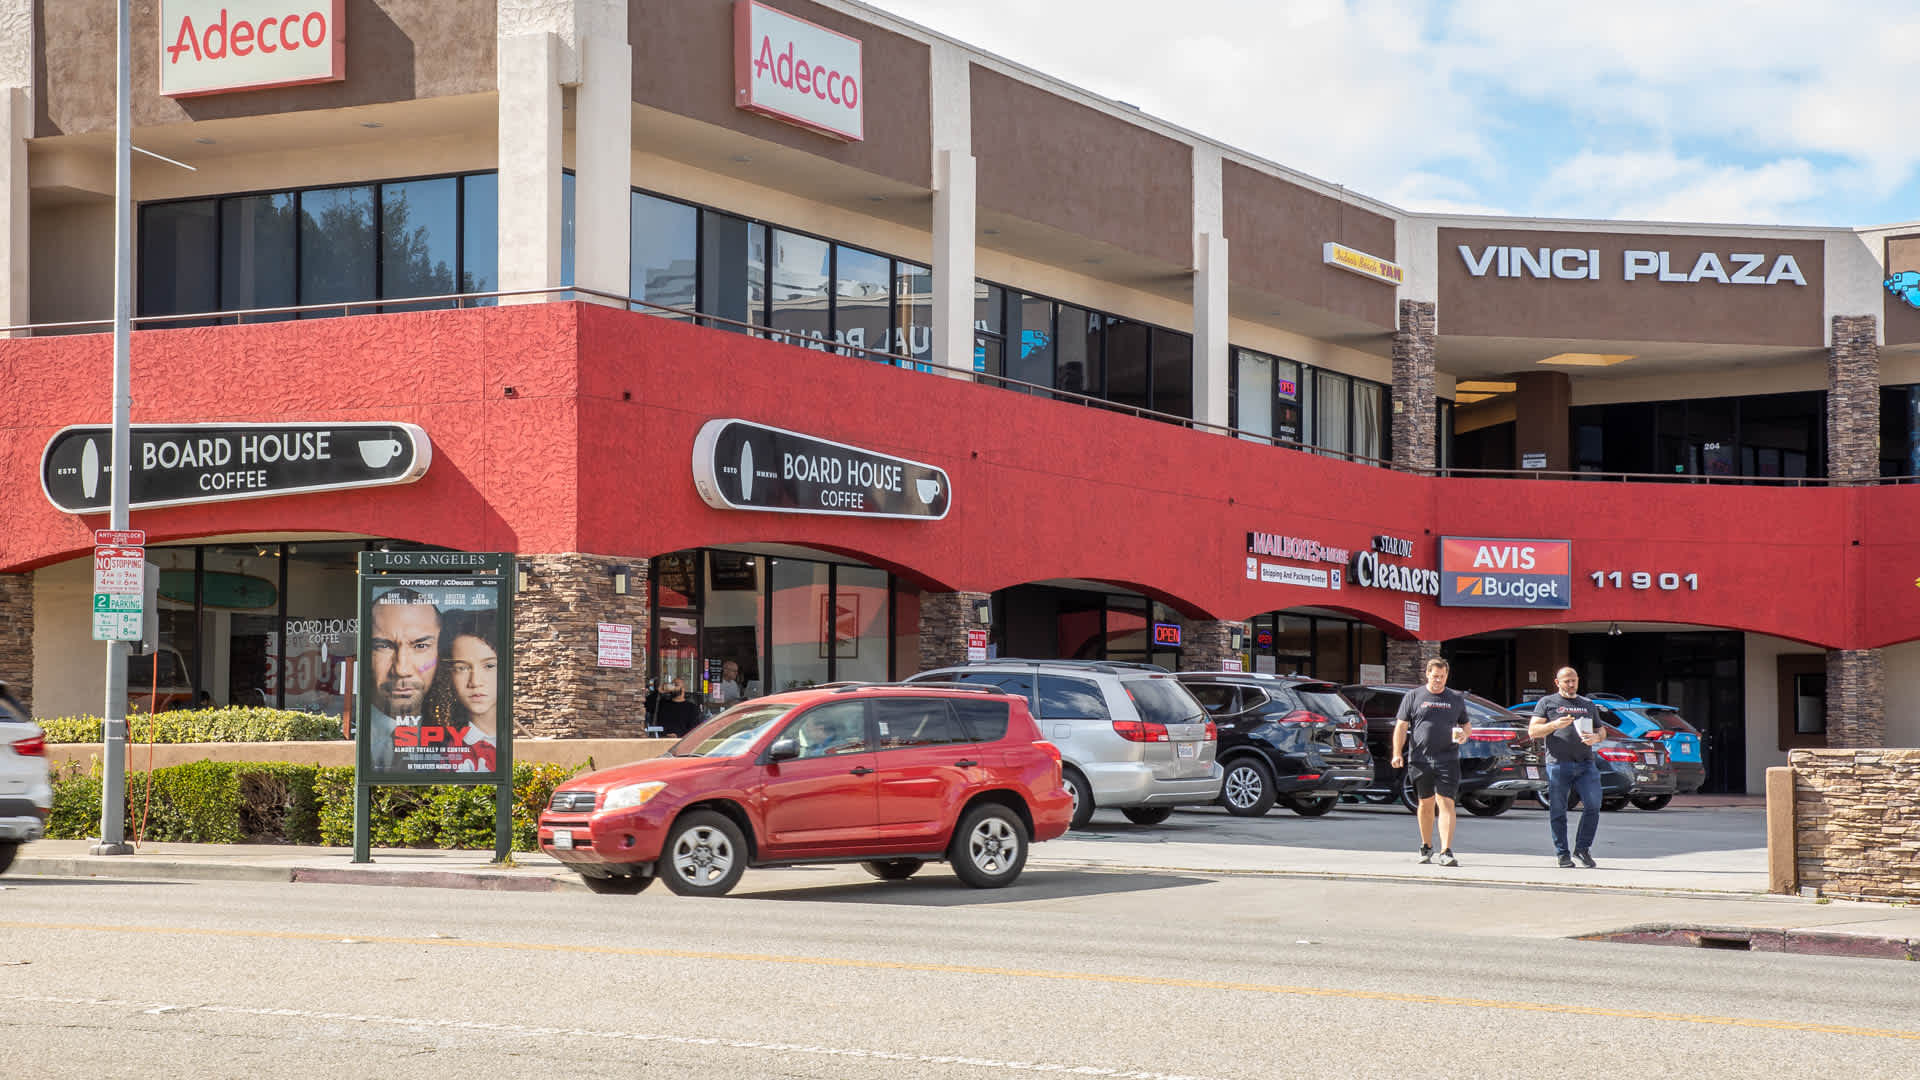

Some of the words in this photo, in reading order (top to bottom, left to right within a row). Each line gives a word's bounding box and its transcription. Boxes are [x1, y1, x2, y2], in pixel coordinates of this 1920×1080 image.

[166, 8, 327, 64] Adecco
[753, 34, 858, 110] Adecco
[1458, 245, 1601, 281] VINCI
[1623, 249, 1808, 287] PLAZA
[142, 437, 232, 470] BOARD
[240, 431, 332, 465] HOUSE
[1704, 442, 1720, 451] 204
[57, 467, 78, 475] ESTD
[199, 469, 268, 491] COFFEE
[783, 452, 842, 485] BOARD
[847, 459, 902, 492] HOUSE
[820, 489, 864, 510] COFFEE
[1253, 531, 1321, 563] MAILBOXES
[1379, 535, 1399, 556] STAR
[96, 558, 111, 570] NO
[111, 559, 142, 569] STOPPING
[385, 554, 411, 565] LOS
[419, 554, 486, 565] ANGELES
[1472, 545, 1536, 570] AVIS
[1262, 567, 1283, 580] Shipping
[1356, 550, 1439, 597] Cleaners
[1591, 571, 1699, 591] 11901
[1483, 576, 1558, 603] Budget
[97, 595, 107, 607] 2
[111, 599, 140, 609] PARKING
[286, 620, 323, 635] BOARD
[1156, 625, 1179, 643] OPEN
[309, 633, 340, 644] COFFEE
[395, 715, 422, 726] MY
[394, 725, 471, 747] SPY
